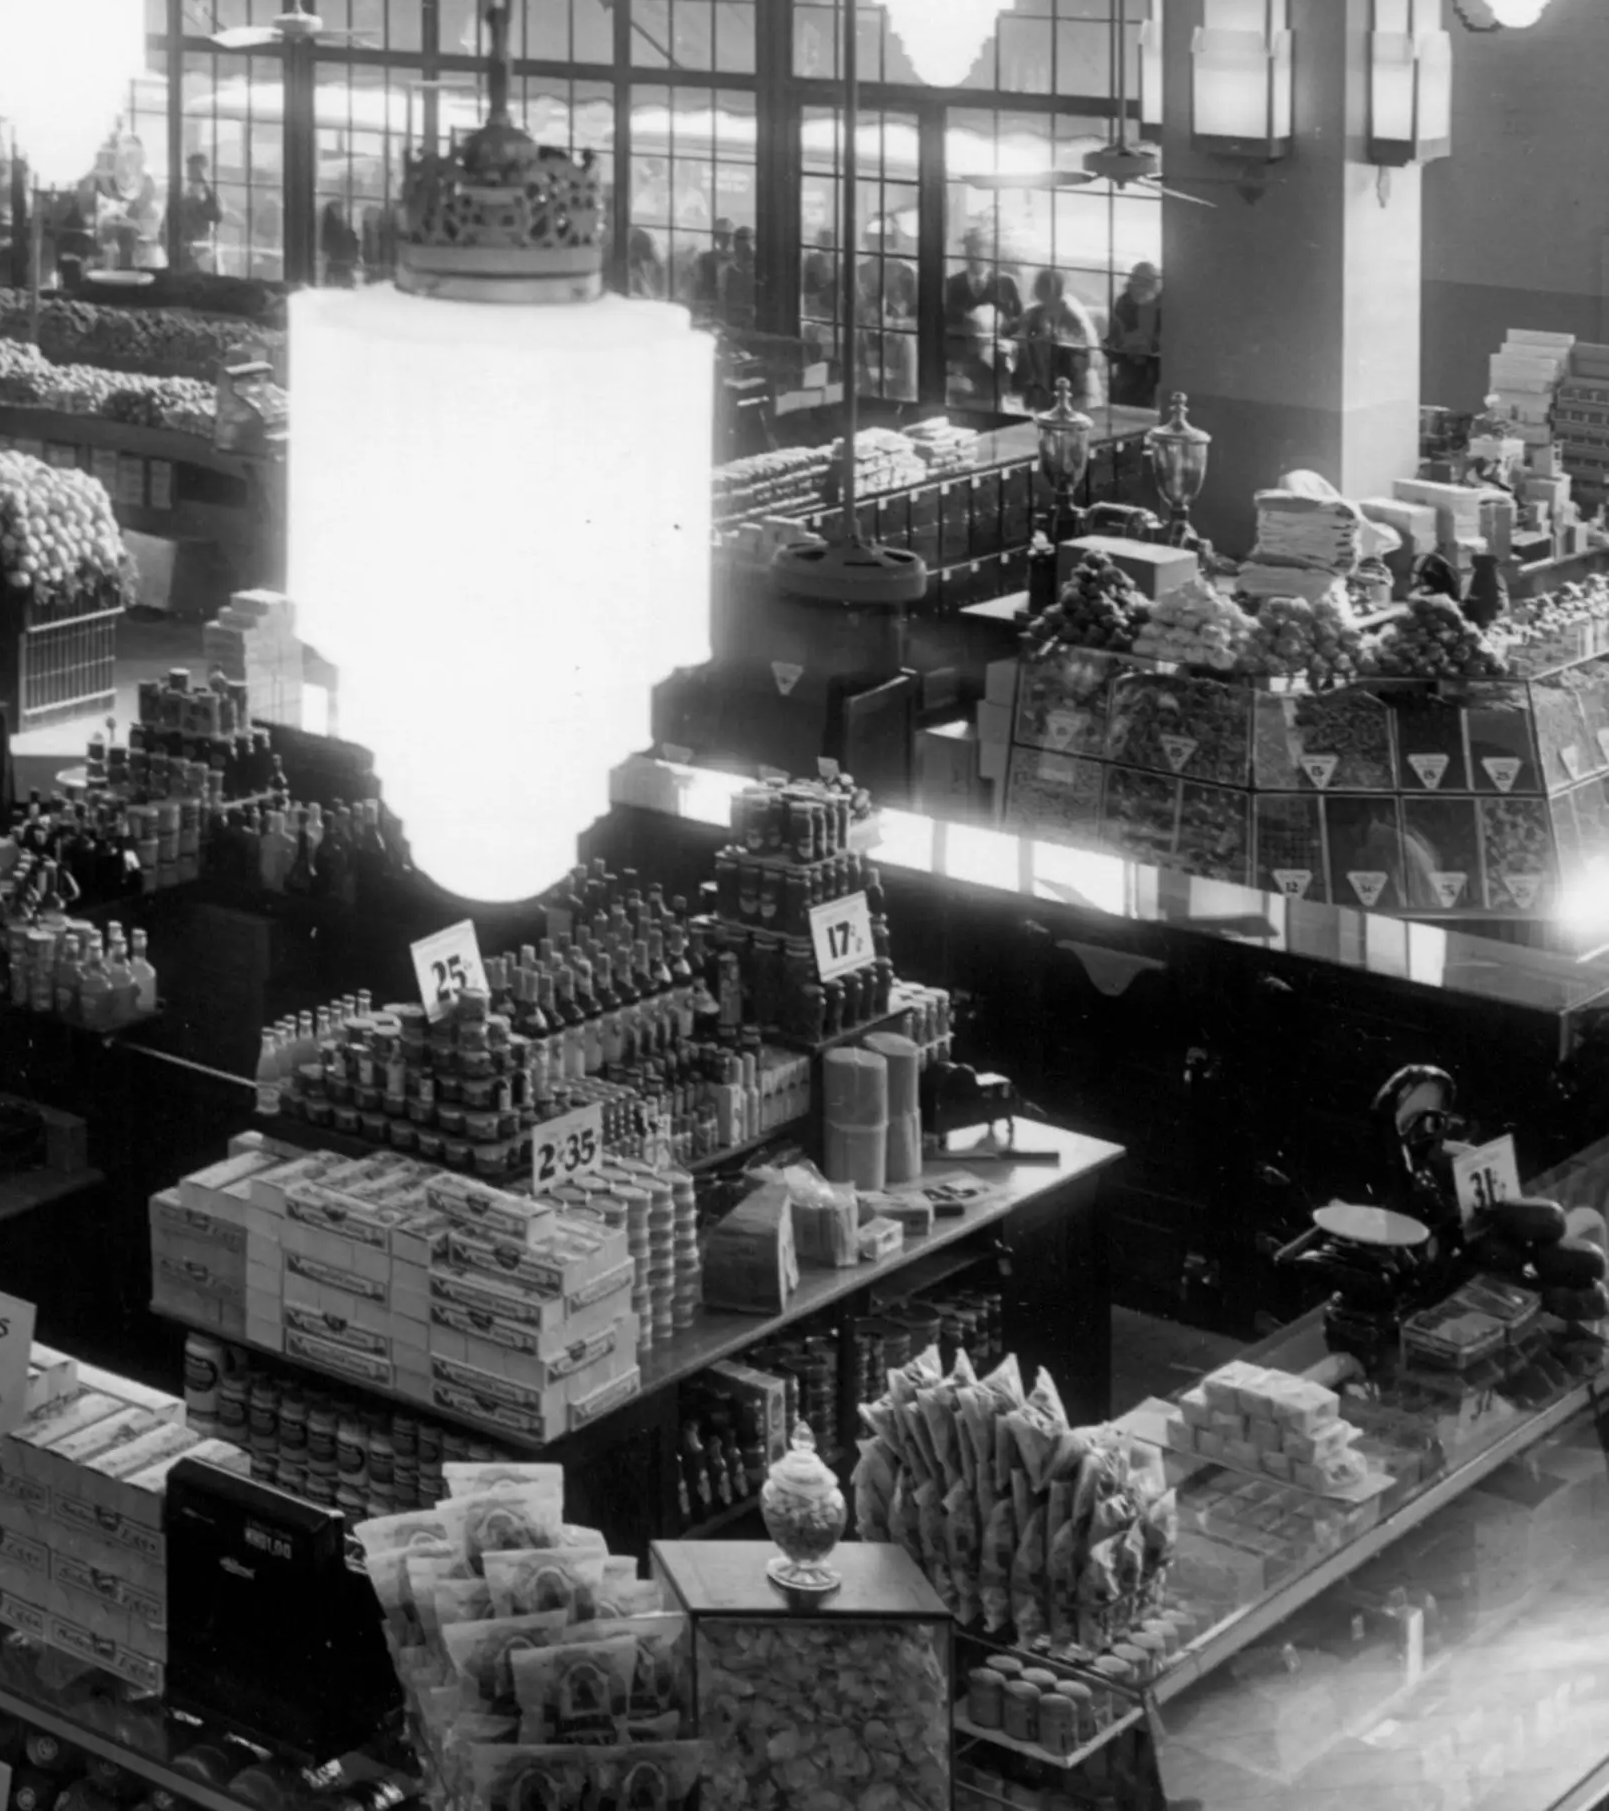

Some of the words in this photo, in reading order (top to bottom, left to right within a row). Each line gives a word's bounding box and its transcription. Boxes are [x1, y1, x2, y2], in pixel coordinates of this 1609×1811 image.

[827, 920, 850, 959] 17
[431, 953, 467, 1002] 25
[538, 1143, 556, 1181] 2
[565, 1128, 596, 1172] 35
